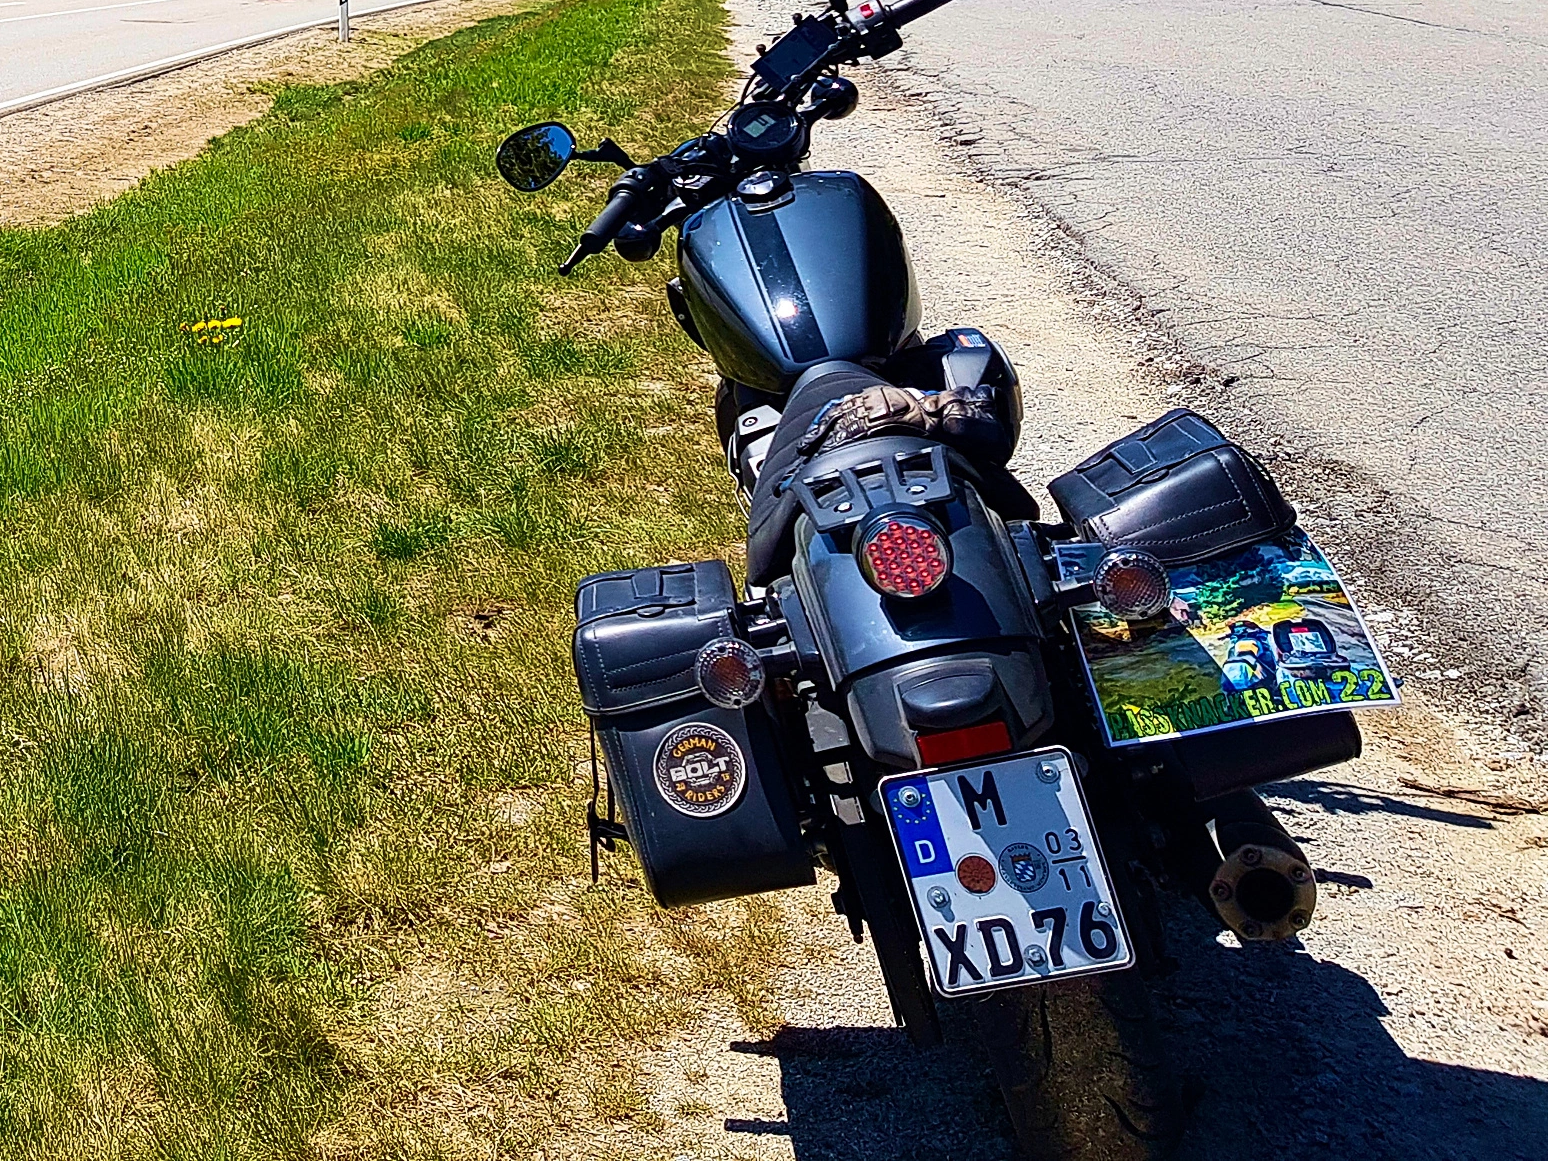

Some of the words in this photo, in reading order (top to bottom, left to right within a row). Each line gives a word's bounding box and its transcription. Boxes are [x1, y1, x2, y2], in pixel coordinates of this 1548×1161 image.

[1109, 679, 1332, 740] PASSKNACKER.COM
[1331, 669, 1391, 702] 22
[672, 736, 716, 757] GERMAN
[669, 756, 730, 782] BOLT
[684, 784, 725, 802] RIDERS
[957, 770, 1008, 830] M
[914, 840, 936, 864] D
[1044, 828, 1082, 854] 03
[1058, 865, 1092, 891] 11
